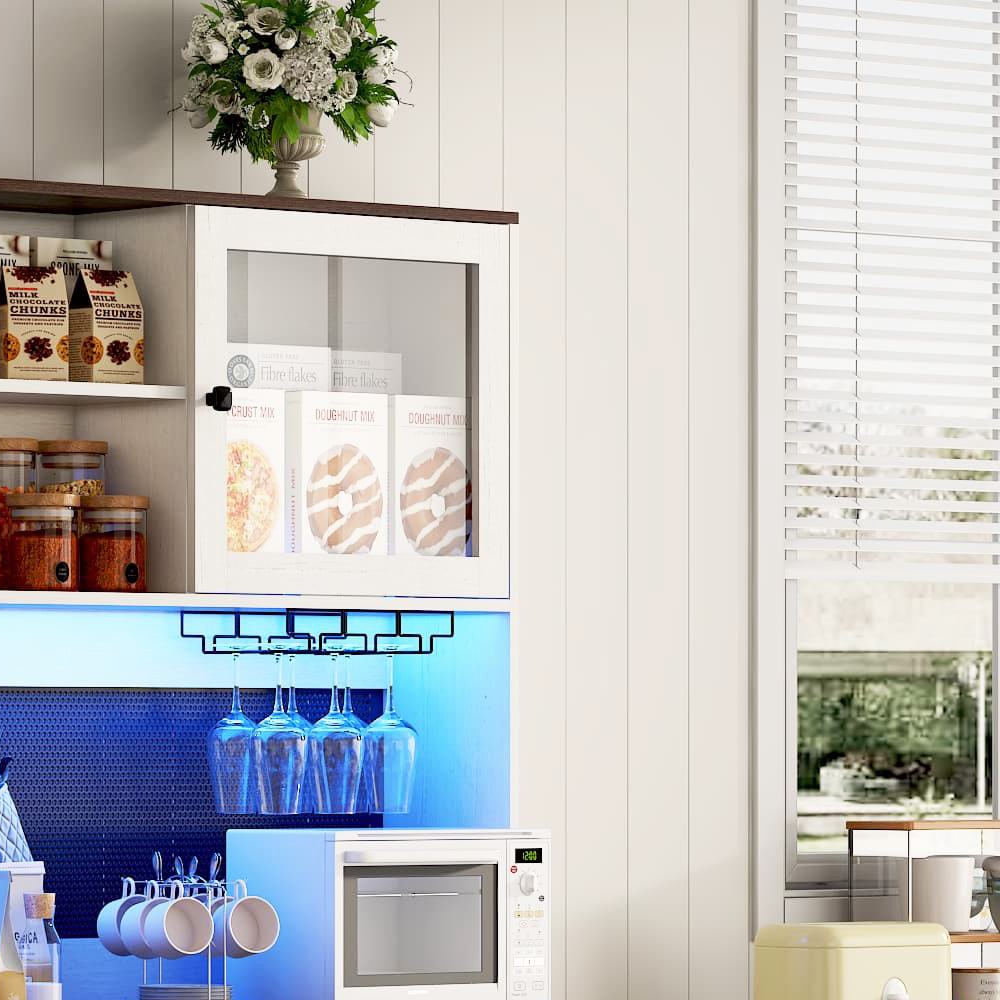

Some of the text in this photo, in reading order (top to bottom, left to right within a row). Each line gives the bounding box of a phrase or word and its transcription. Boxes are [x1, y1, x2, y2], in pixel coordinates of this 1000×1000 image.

[10, 306, 67, 315] CHUNKS
[93, 302, 142, 310] CHOCOLATE
[95, 308, 142, 319] CHUNKS
[260, 366, 286, 383] Fibre
[288, 367, 317, 384] flakes
[333, 371, 388, 389] Fibre flakes
[231, 405, 275, 419] CRUST MIX
[315, 408, 375, 423] DOUGHNUT MIX
[408, 412, 451, 426] DOUGHNUT
